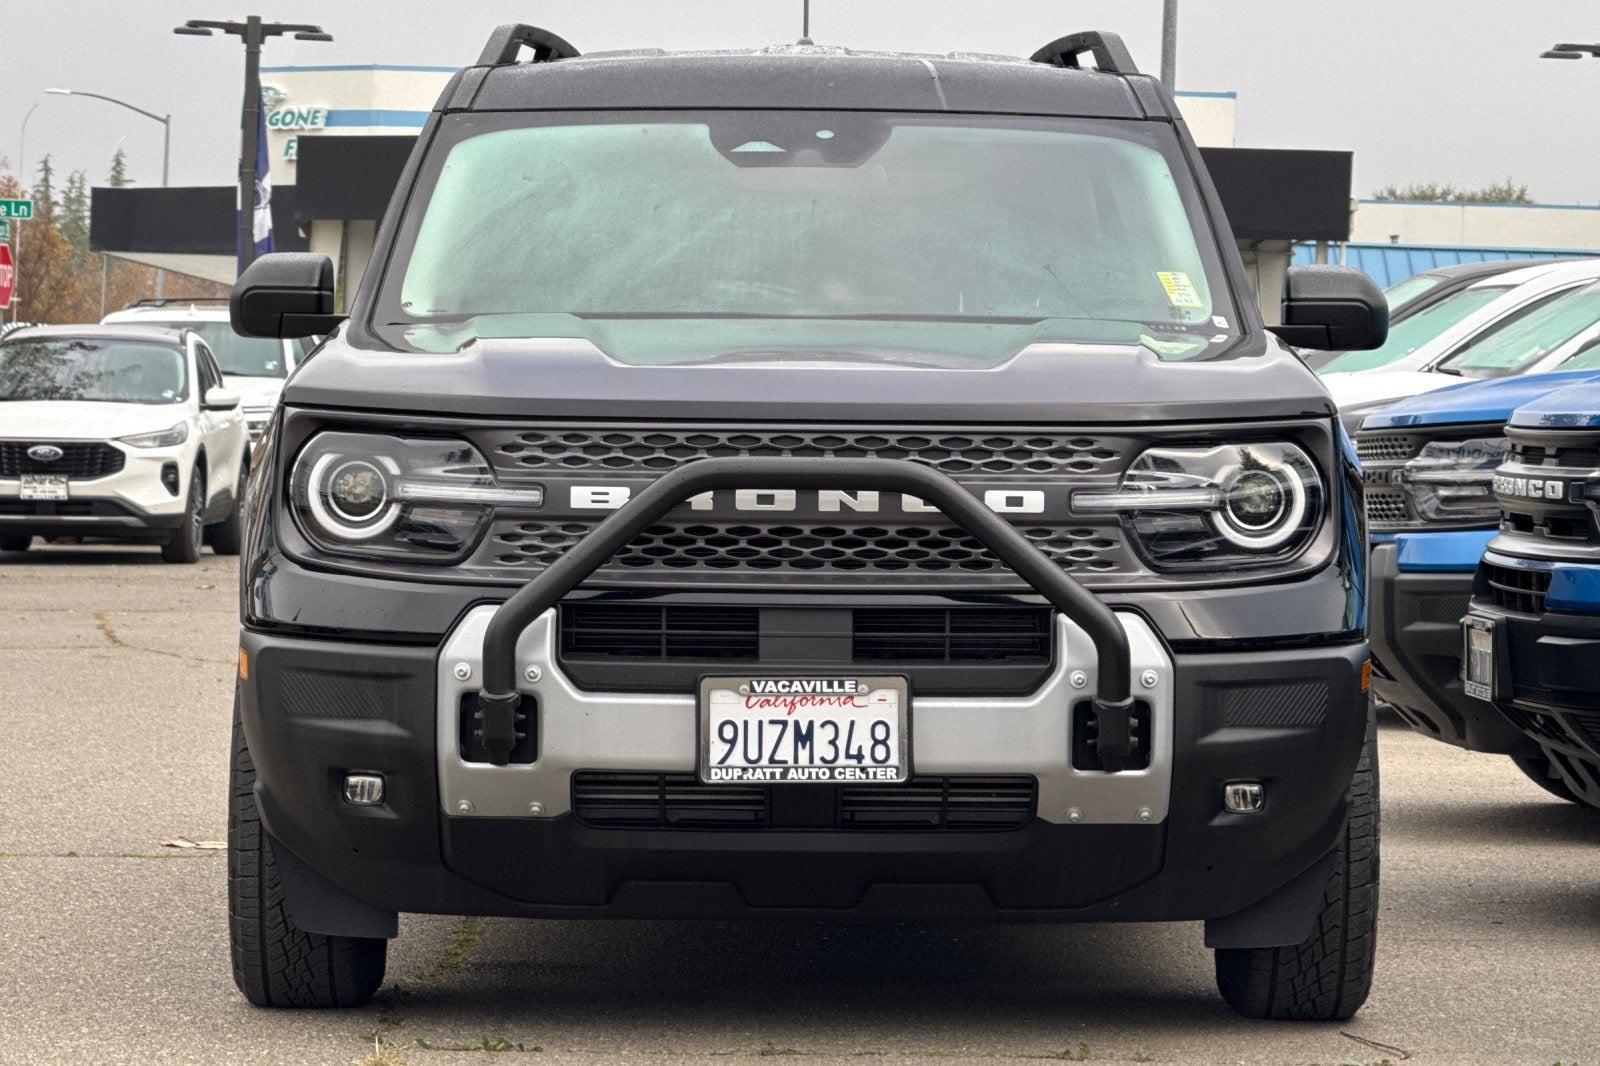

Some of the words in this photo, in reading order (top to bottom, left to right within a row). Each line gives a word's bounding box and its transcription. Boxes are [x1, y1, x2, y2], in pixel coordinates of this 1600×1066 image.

[268, 109, 321, 127] GONE
[11, 202, 28, 217] Ln
[570, 485, 1045, 513] BONO
[752, 680, 857, 693] VACAVILLE
[744, 694, 869, 716] California
[717, 719, 891, 765] 9UZM348
[710, 767, 783, 780] DUPRATT
[787, 767, 830, 780] AUTO
[834, 767, 898, 780] CENTER
